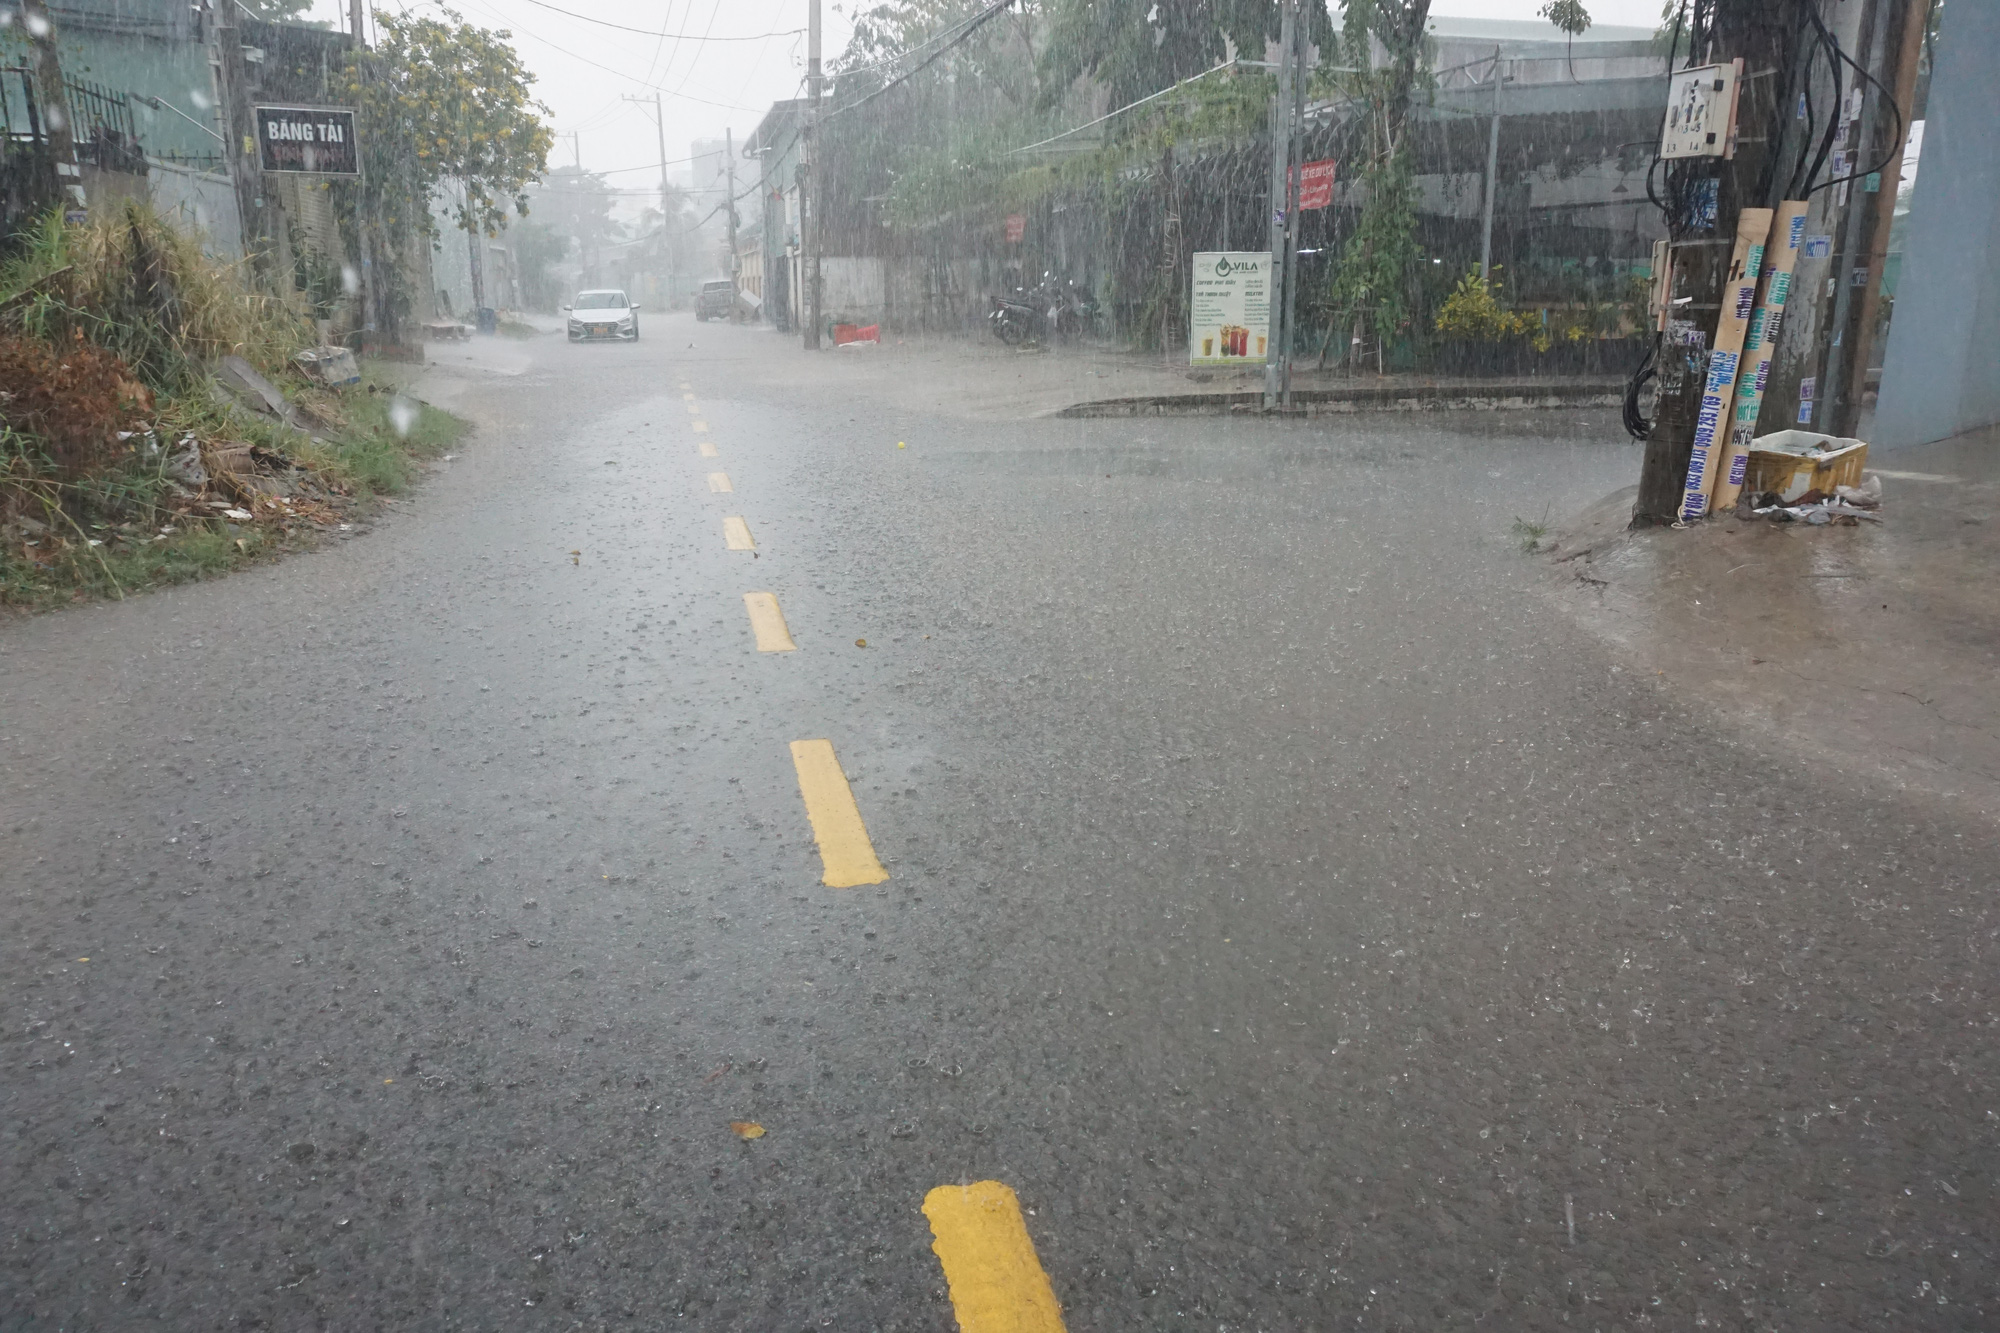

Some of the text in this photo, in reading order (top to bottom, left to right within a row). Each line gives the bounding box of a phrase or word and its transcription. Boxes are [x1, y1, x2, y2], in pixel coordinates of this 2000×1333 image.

[268, 118, 344, 142] BĂNG TẢI
[1666, 142, 1699, 153] 13 14
[1233, 262, 1258, 271] VILA
[1695, 395, 1722, 447] 0909.293.769
